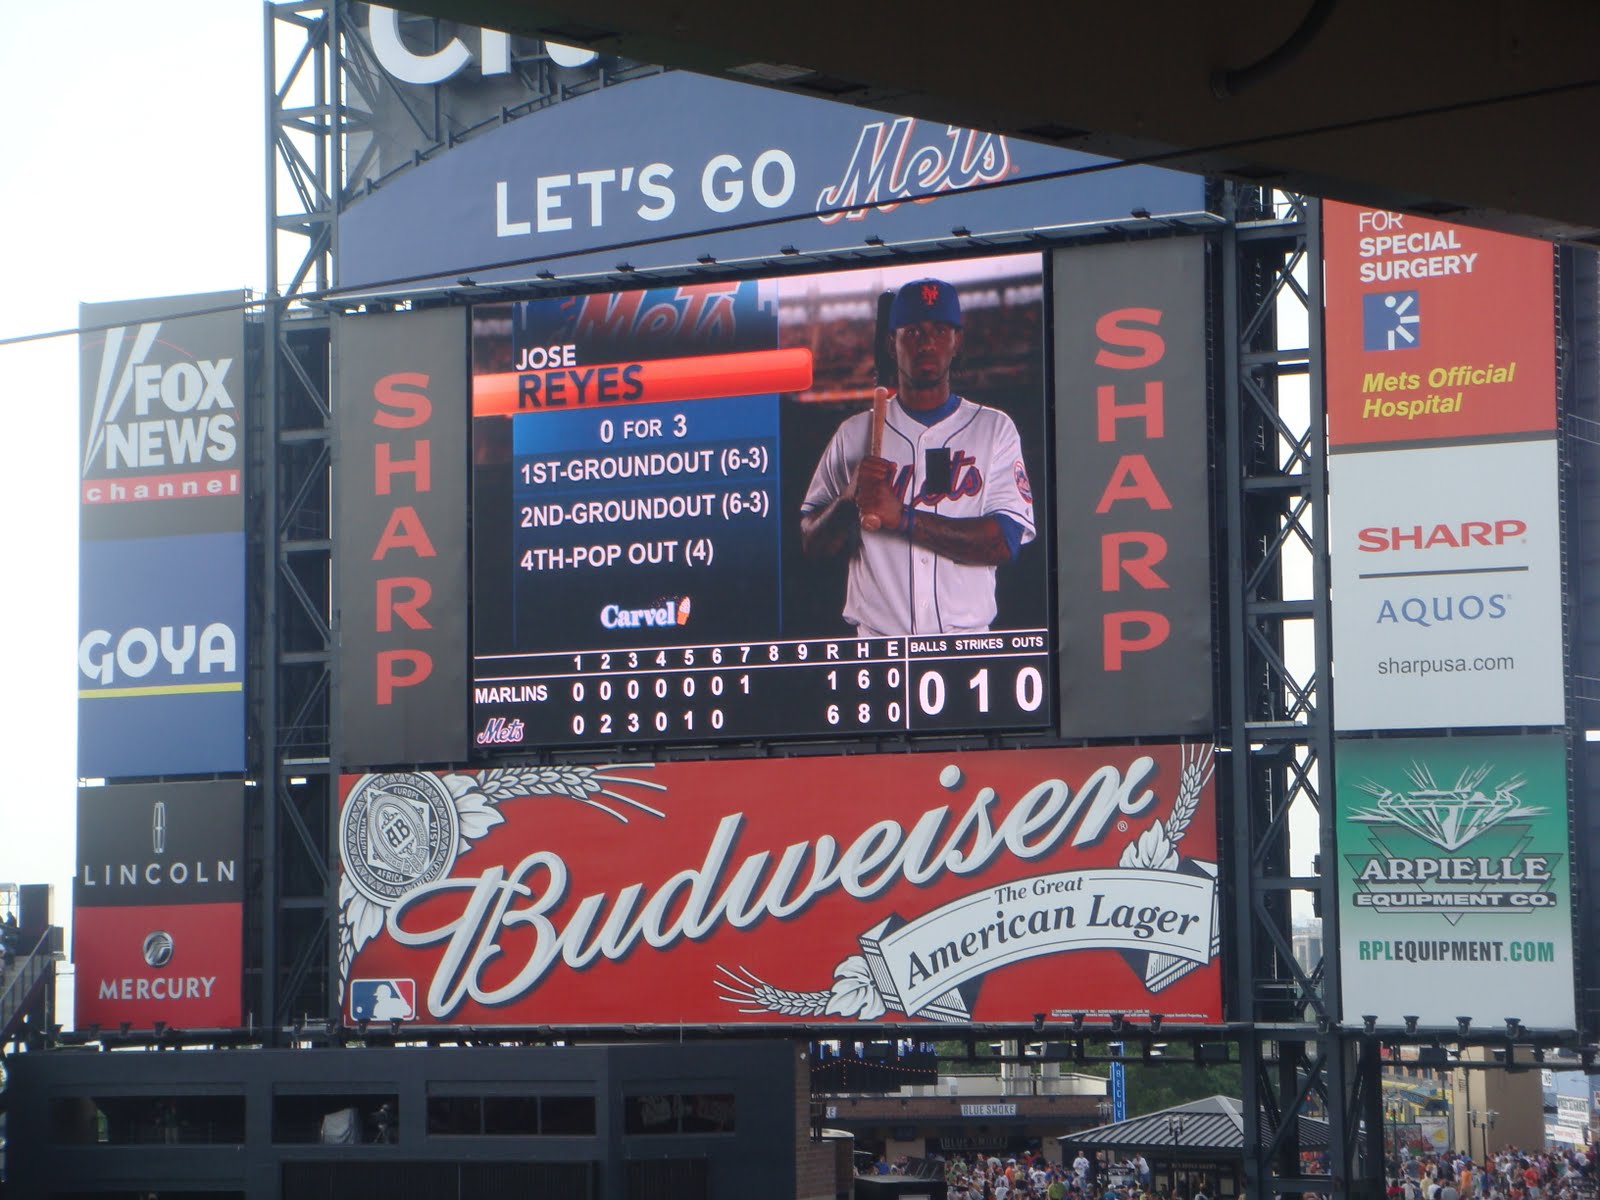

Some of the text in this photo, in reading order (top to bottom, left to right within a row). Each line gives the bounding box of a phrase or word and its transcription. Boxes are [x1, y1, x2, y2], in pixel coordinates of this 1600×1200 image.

[496, 117, 1010, 238] LET'S GO Mets
[1359, 210, 1403, 232] FOR
[1359, 230, 1461, 257] SPECIAL
[1359, 253, 1478, 282] SURGERY
[515, 344, 576, 370] JOSE
[134, 358, 234, 416] FOX
[517, 364, 644, 408] REYES
[1362, 362, 1516, 393] Mets Official
[1362, 392, 1462, 420] Hospital
[106, 414, 236, 469] NEWS
[600, 414, 687, 443] 0 FOR 3
[521, 446, 769, 485] 1ST-GROUNDOUT (6-3)
[86, 474, 238, 502] channel
[1095, 307, 1173, 671] SHARP
[521, 490, 770, 528] 2ND-GROUNDOUT (6-3)
[372, 372, 437, 705] SHARP
[1358, 519, 1527, 552] SHARP
[520, 539, 714, 571] 4TH-POP OUT (4)
[600, 601, 676, 629] Carvel
[1376, 593, 1507, 627] AQUOS
[79, 622, 236, 685] GOYA
[573, 641, 898, 671] 1 2 3 4 5 6 7 8 9 R H E
[910, 636, 1044, 653] BALLS STRIKES OUTS
[1378, 656, 1514, 677] sharpusa.com
[474, 668, 900, 704] MARLINS 0 0 0 0 0 0 1 1 6 0
[919, 667, 1043, 715] 0 1 0
[477, 702, 900, 744] Mets 0 2 3 0 1 0 6 8 0
[393, 786, 420, 800] EUROPE
[430, 821, 438, 847] ASIA
[84, 860, 235, 886] LINCOLN
[377, 869, 403, 882] AFRICA
[1360, 857, 1551, 883] ARPIELLE
[386, 756, 1154, 1019] Budweiser
[994, 876, 1084, 905] The Great
[1357, 894, 1556, 906] EQUIPMENT CO.
[908, 894, 1200, 990] American Lager
[1359, 941, 1554, 962] RPLEQUIPMENT.COM
[98, 976, 216, 1000] MERCURY
[963, 1104, 1014, 1115] BLUE SMOKE
